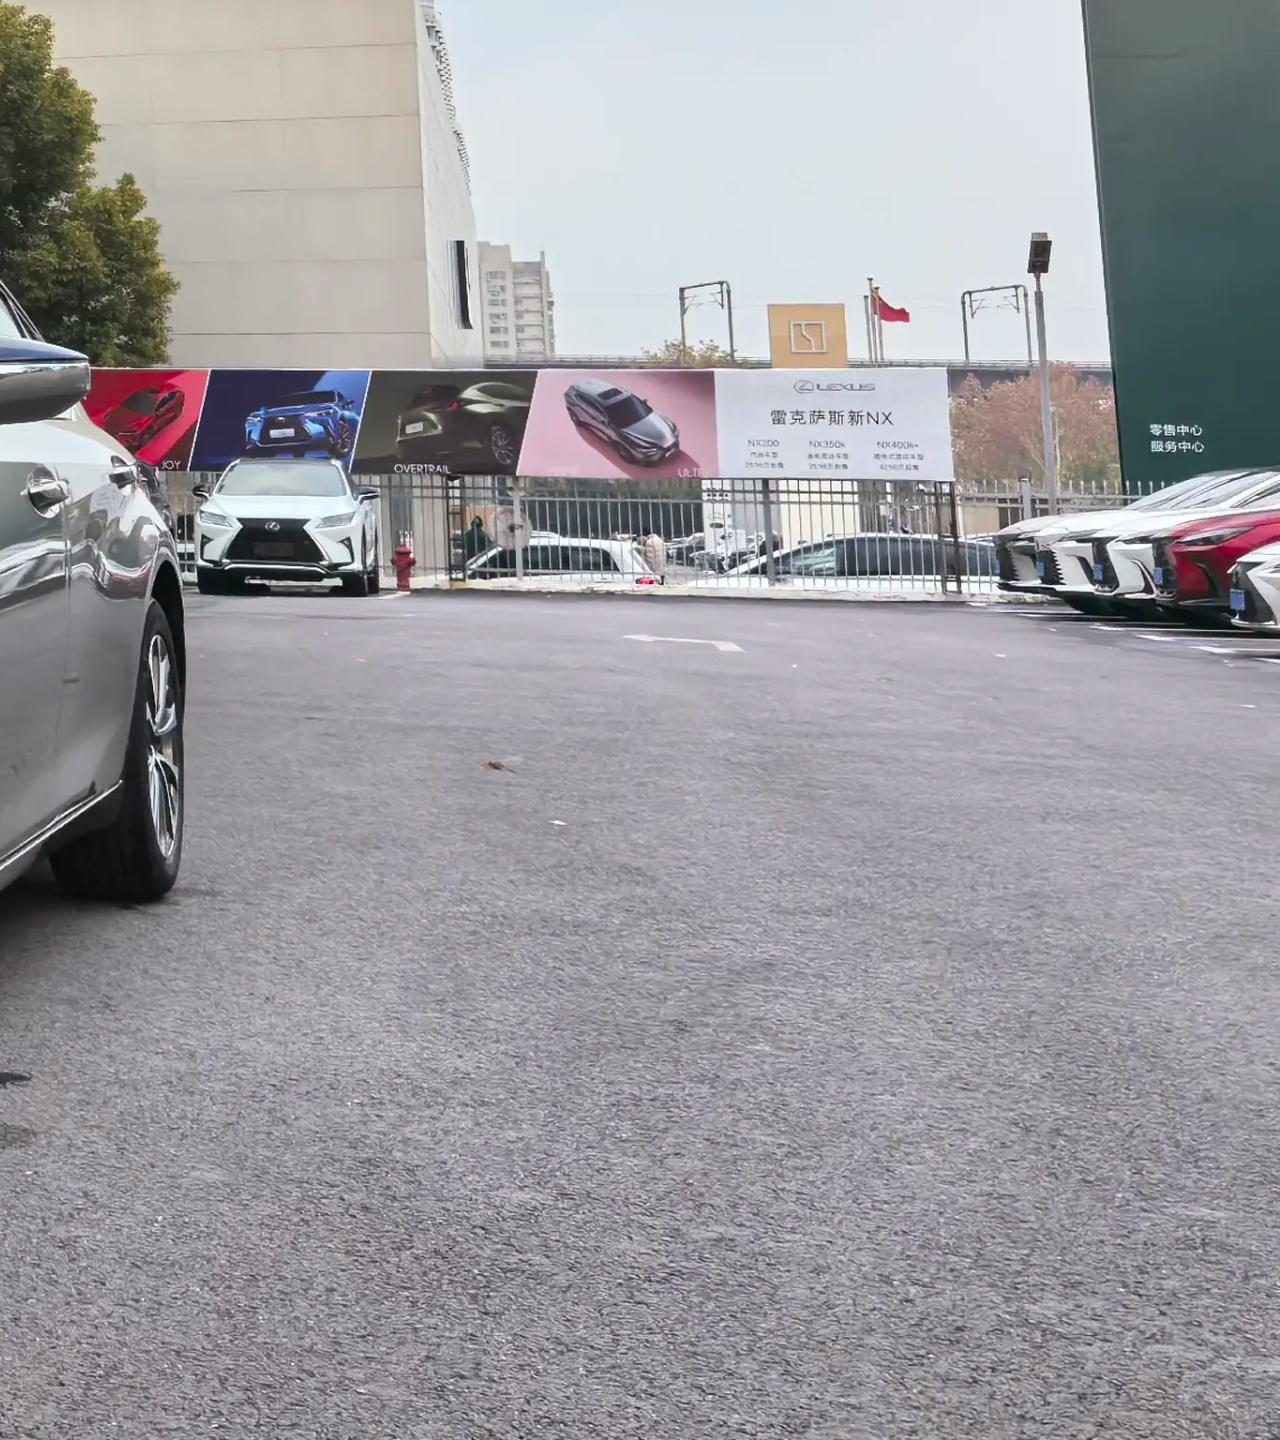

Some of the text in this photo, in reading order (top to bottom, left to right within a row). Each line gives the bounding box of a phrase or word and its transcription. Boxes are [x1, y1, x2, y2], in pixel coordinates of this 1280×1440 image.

[816, 382, 876, 392] LEXUS
[770, 409, 894, 427] 雷克萨斯新NX
[1149, 423, 1203, 437] 零售中心
[1150, 440, 1205, 453] 服务中心
[161, 460, 181, 470] JOY
[393, 463, 451, 473] OVERTRAIL
